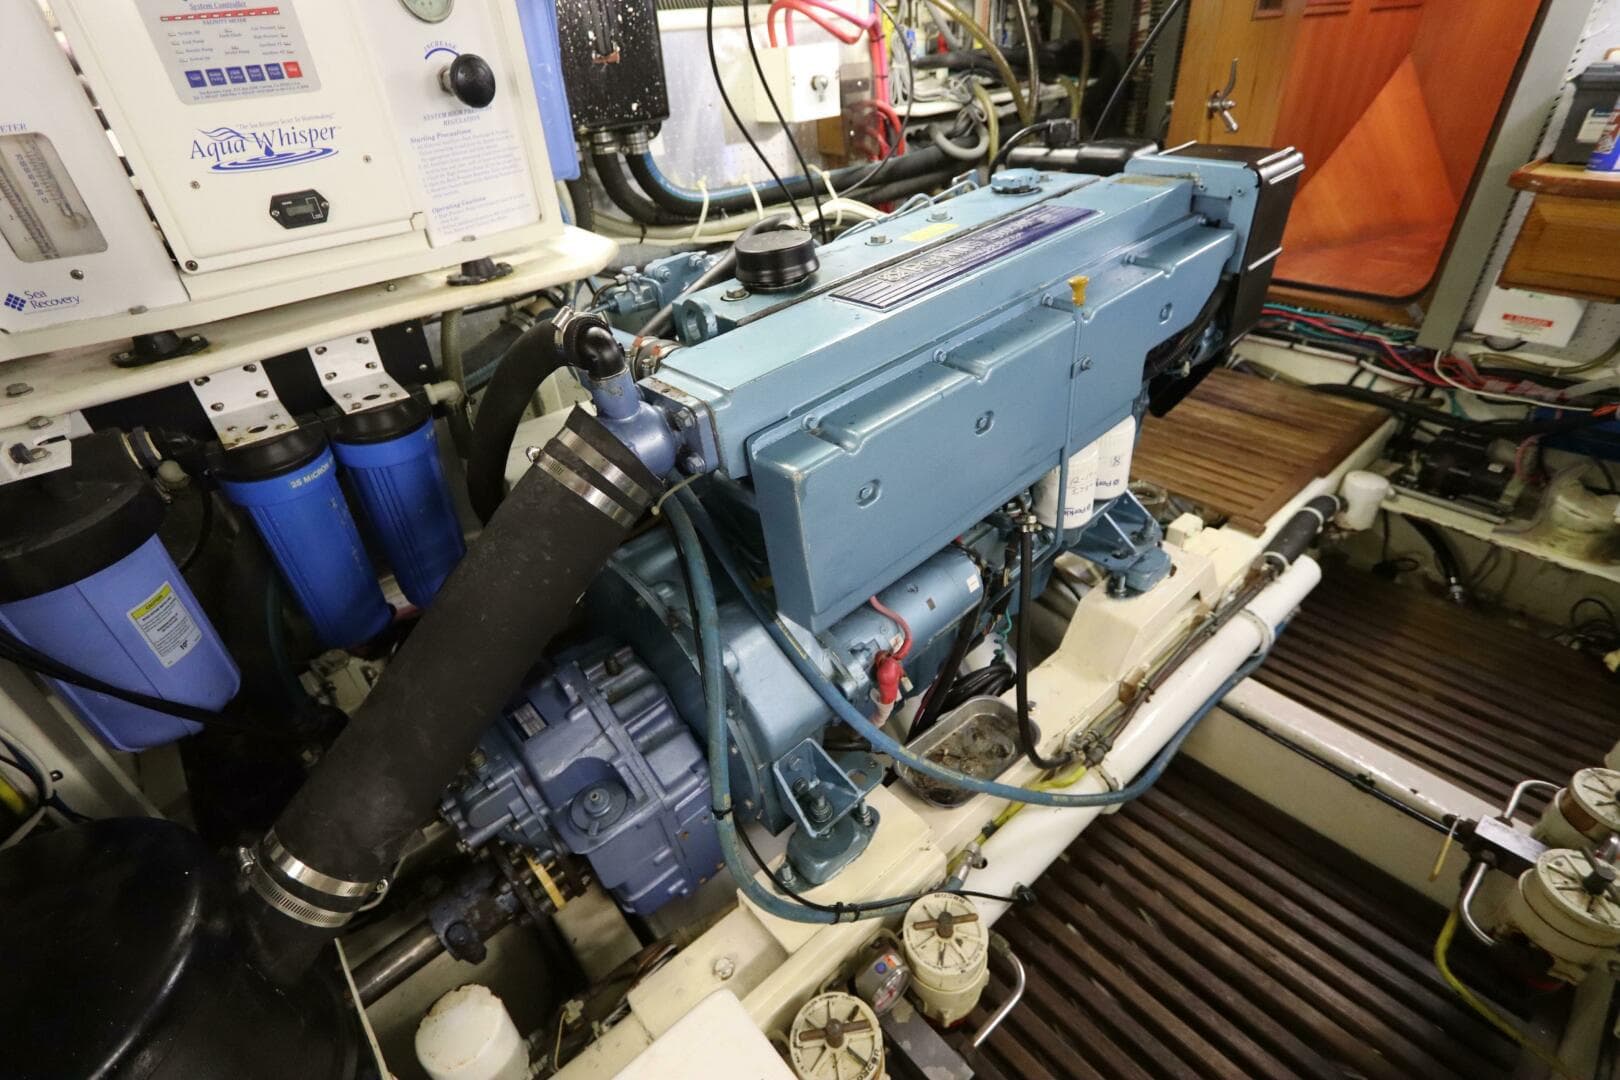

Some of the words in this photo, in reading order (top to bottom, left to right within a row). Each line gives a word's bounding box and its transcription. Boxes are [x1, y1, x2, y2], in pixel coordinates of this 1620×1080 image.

[424, 41, 457, 53] INCREASE
[190, 140, 246, 161] Aqua
[249, 126, 335, 148] Whisper
[24, 290, 47, 300] Sea
[30, 296, 80, 309] Recovery
